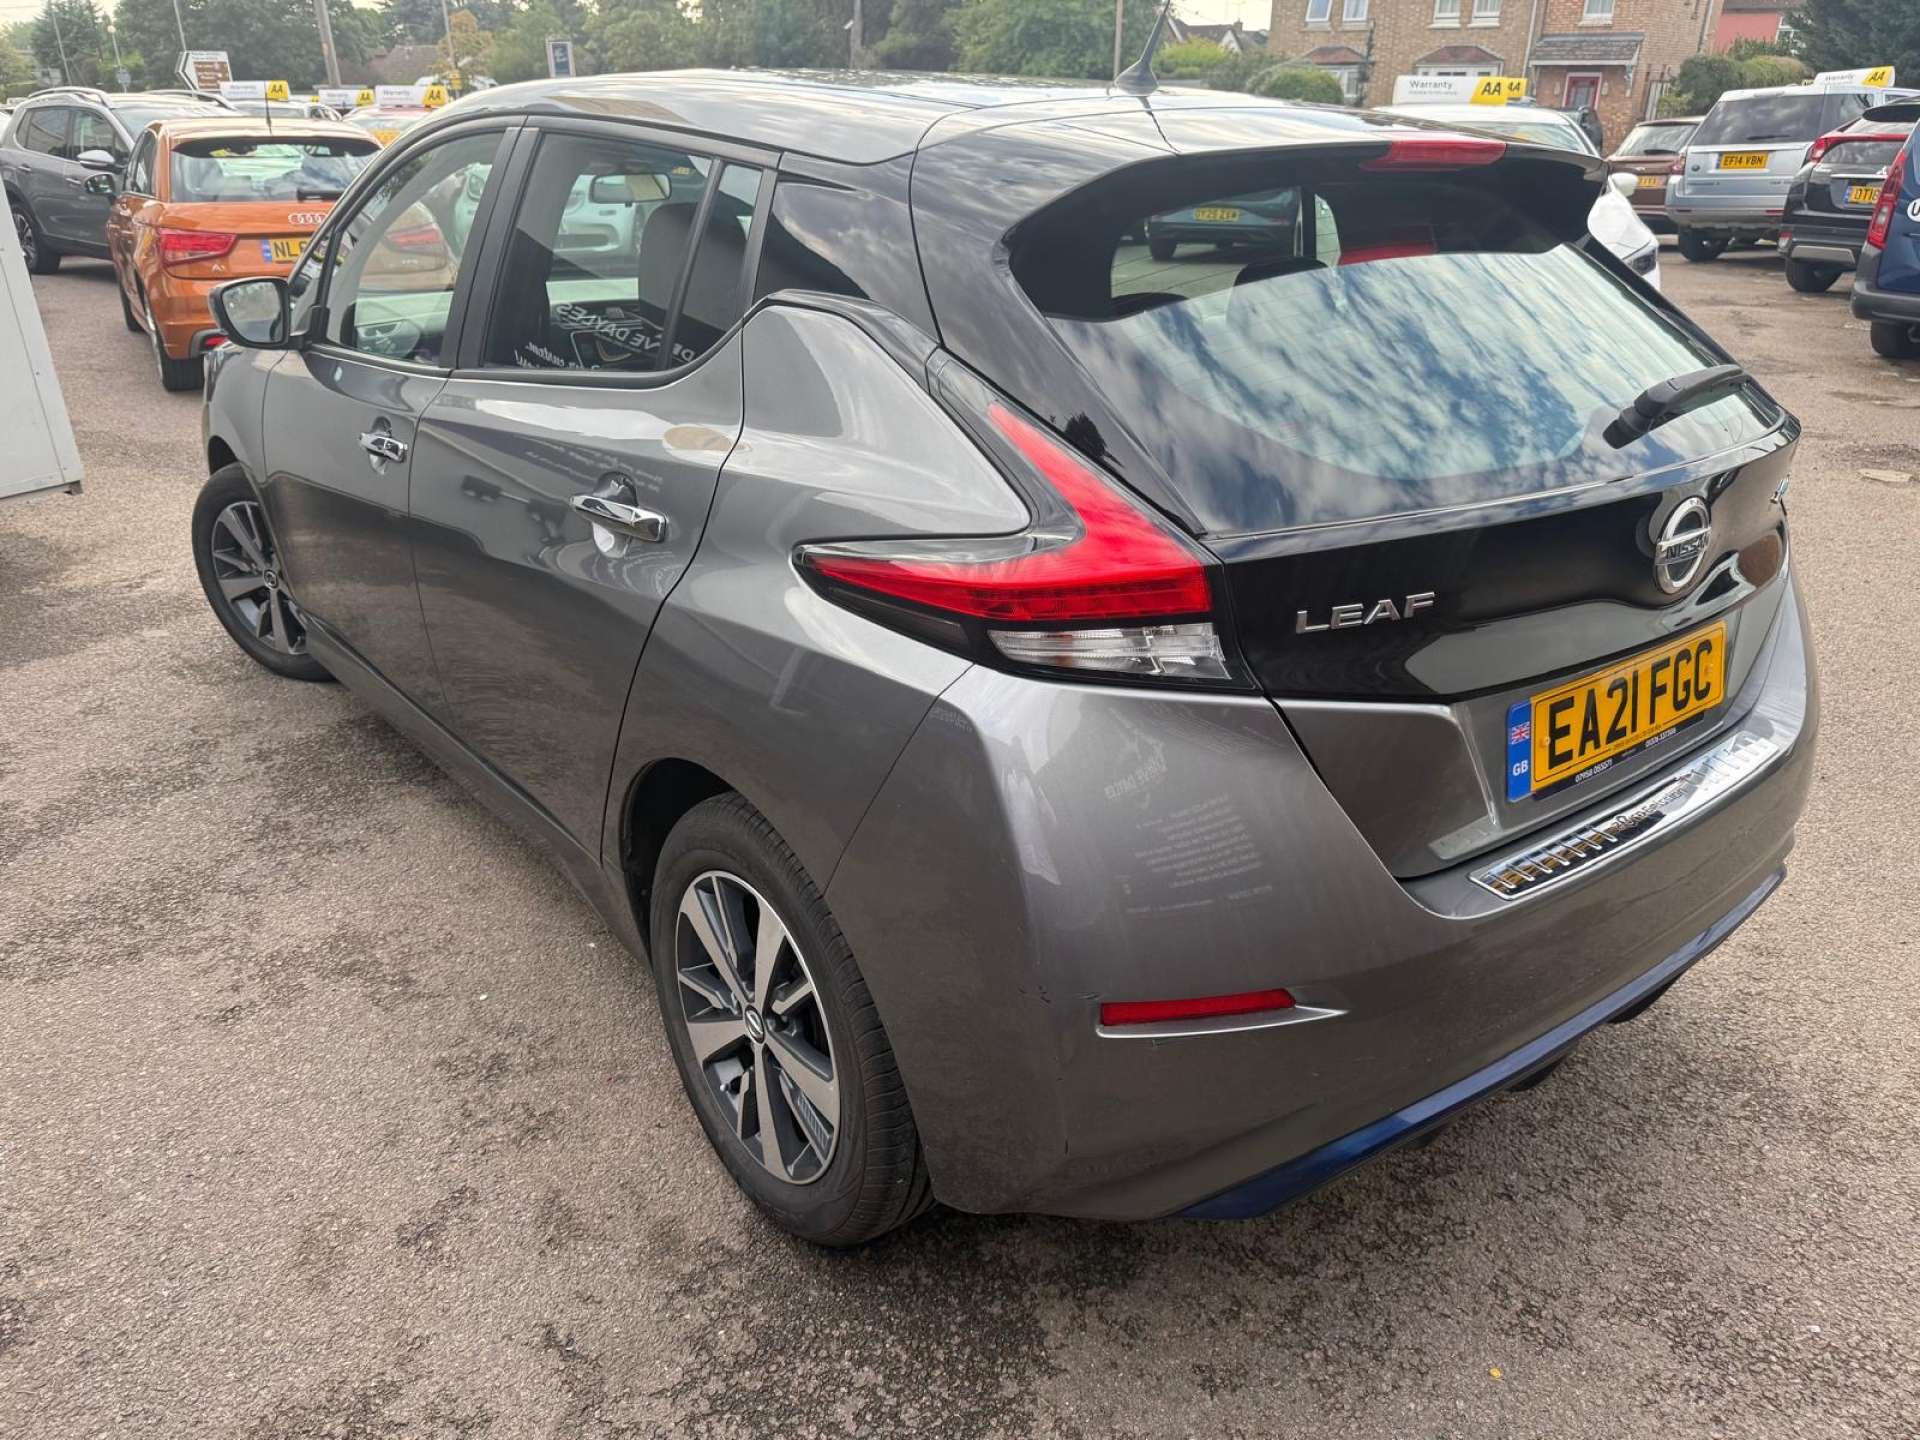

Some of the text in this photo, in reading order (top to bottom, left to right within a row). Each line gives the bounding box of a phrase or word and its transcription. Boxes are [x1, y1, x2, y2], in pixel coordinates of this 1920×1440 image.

[1868, 71, 1886, 82] AA
[270, 84, 284, 93] AA
[1410, 80, 1453, 90] Warranty
[1480, 81, 1502, 96] AA
[361, 91, 371, 100] AA
[427, 89, 441, 100] AA
[1296, 592, 1435, 634] LEAF
[1548, 639, 1712, 770] EA21 FGC
[1512, 759, 1528, 776] GB
